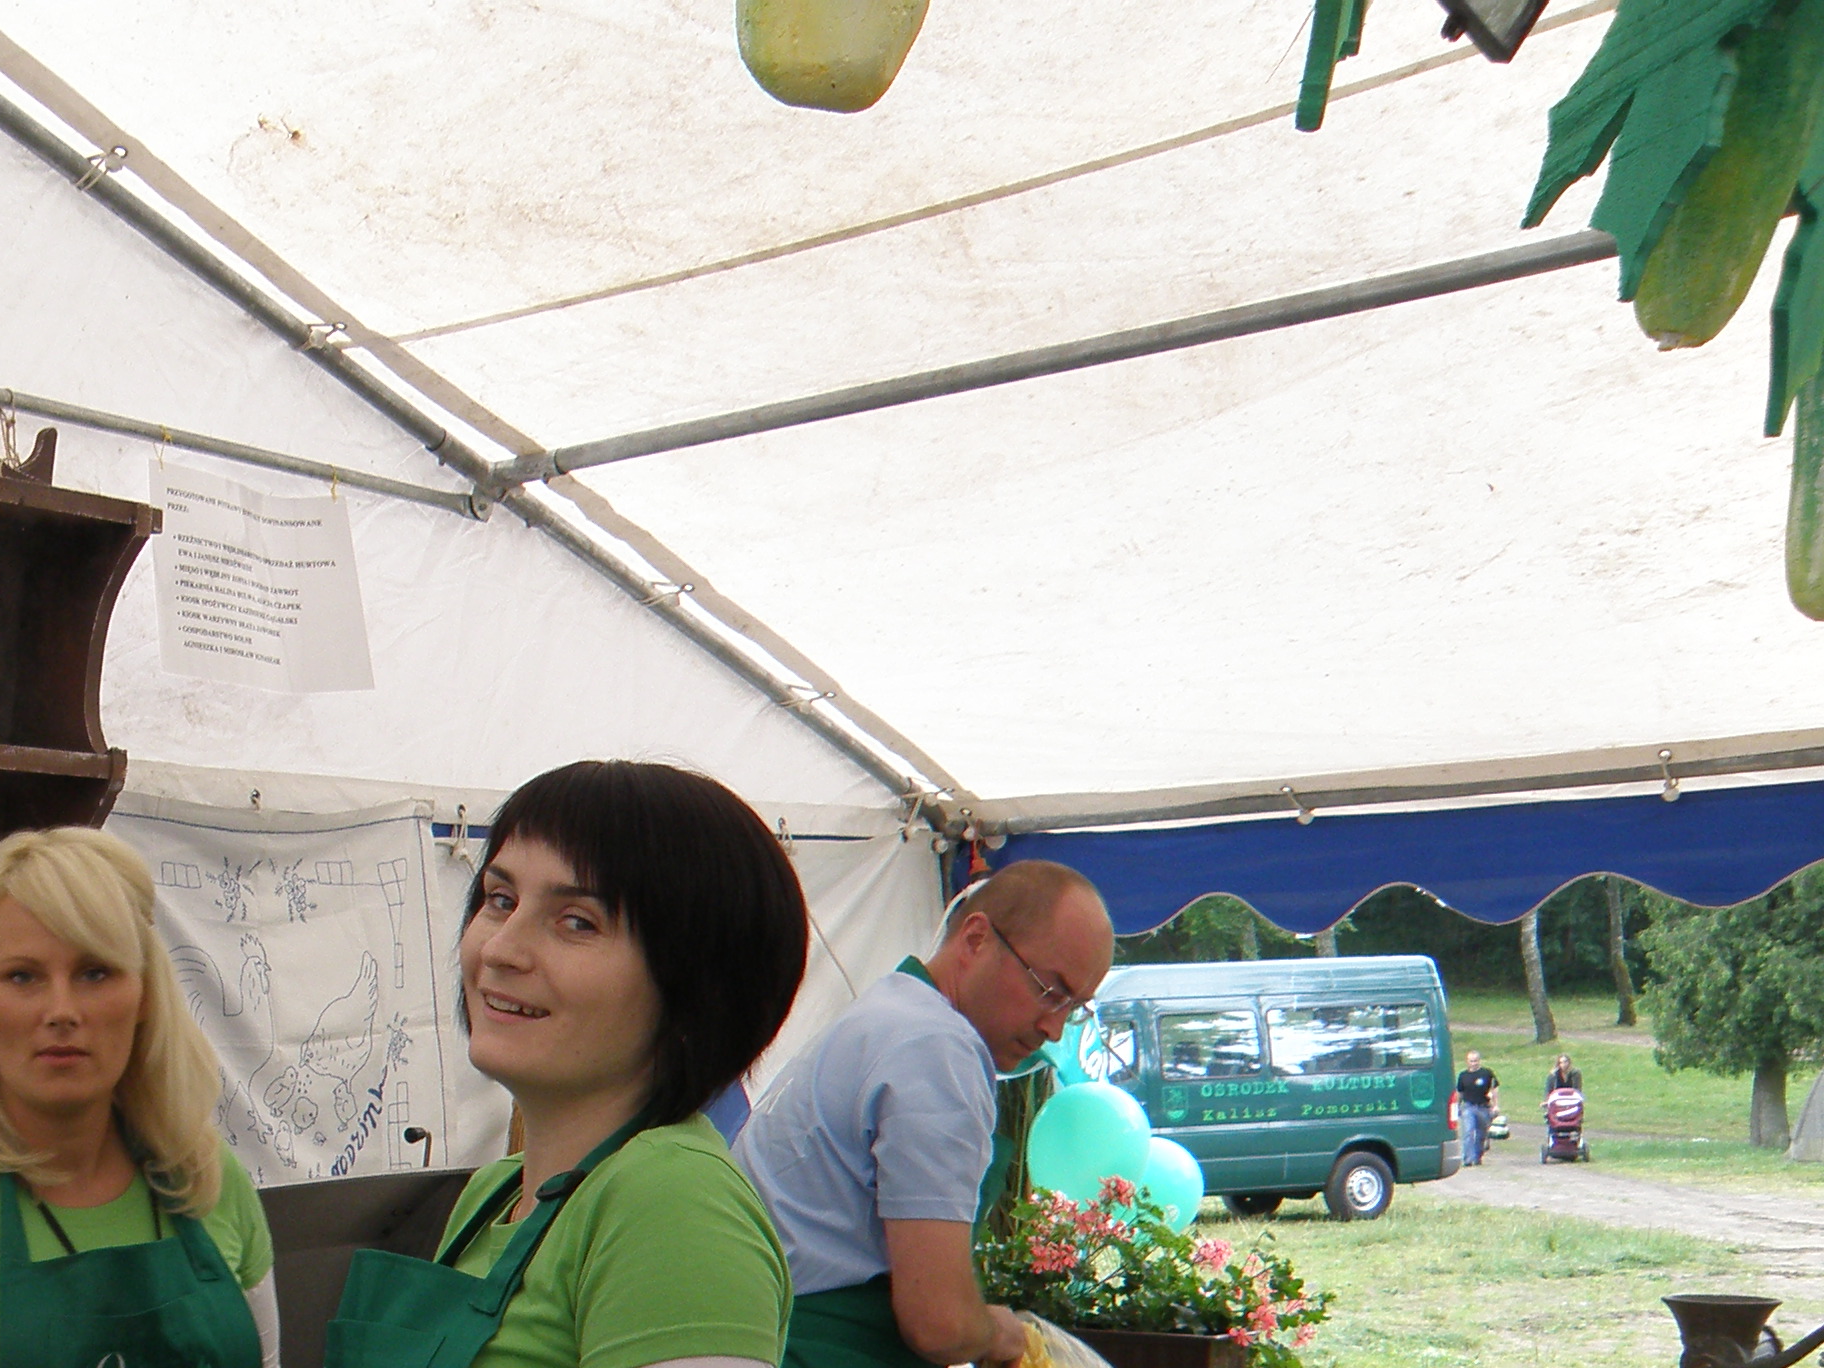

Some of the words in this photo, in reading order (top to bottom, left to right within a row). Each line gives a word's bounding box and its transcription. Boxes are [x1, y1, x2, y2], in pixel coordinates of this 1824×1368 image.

[1311, 1073, 1396, 1092] KULTURY
[1202, 1106, 1277, 1122] Kalisz
[1300, 1099, 1399, 1117] Pomorski
